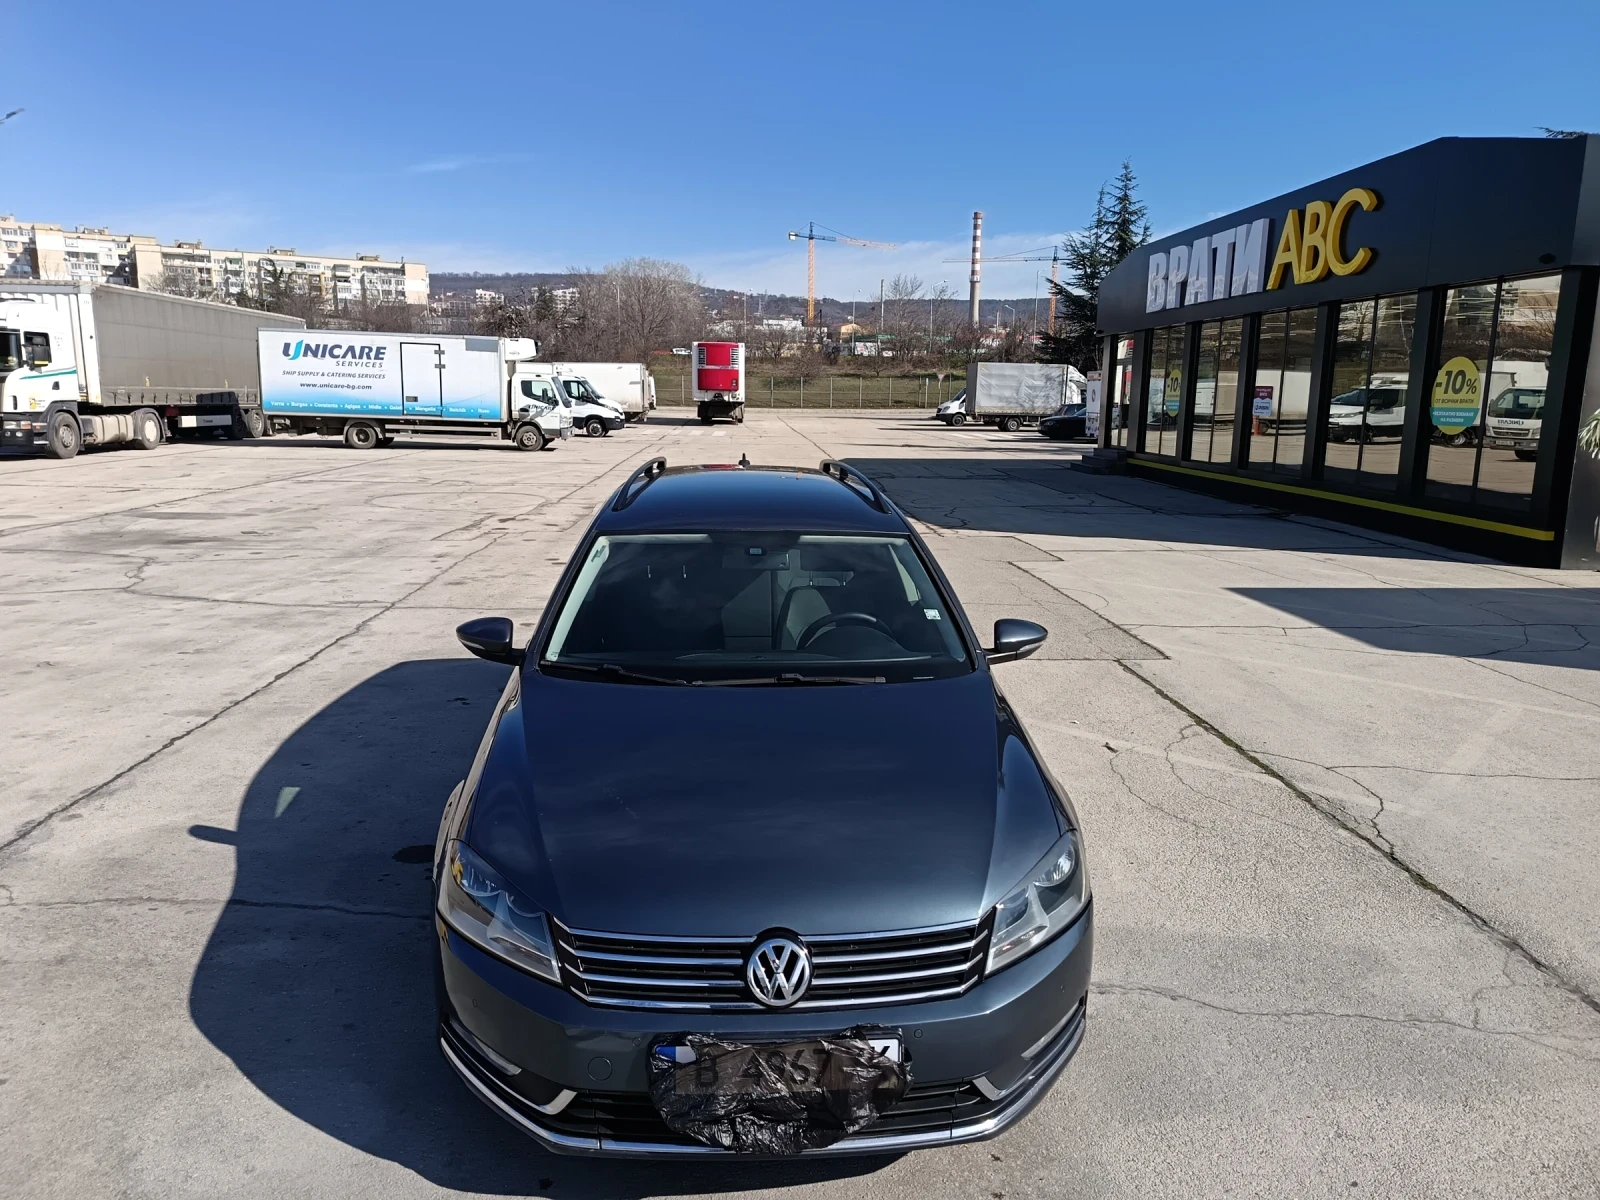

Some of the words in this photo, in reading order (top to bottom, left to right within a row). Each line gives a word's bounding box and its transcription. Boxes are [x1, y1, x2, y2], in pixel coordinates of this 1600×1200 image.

[1146, 218, 1270, 314] ВРАТИ
[282, 339, 387, 361] UNICARE
[335, 360, 384, 369] SERVICES
[326, 371, 356, 379] CATERING
[357, 372, 386, 380] SERVICES
[1435, 369, 1478, 395] -10%
[299, 382, 373, 391] www.unicare-bg.com
